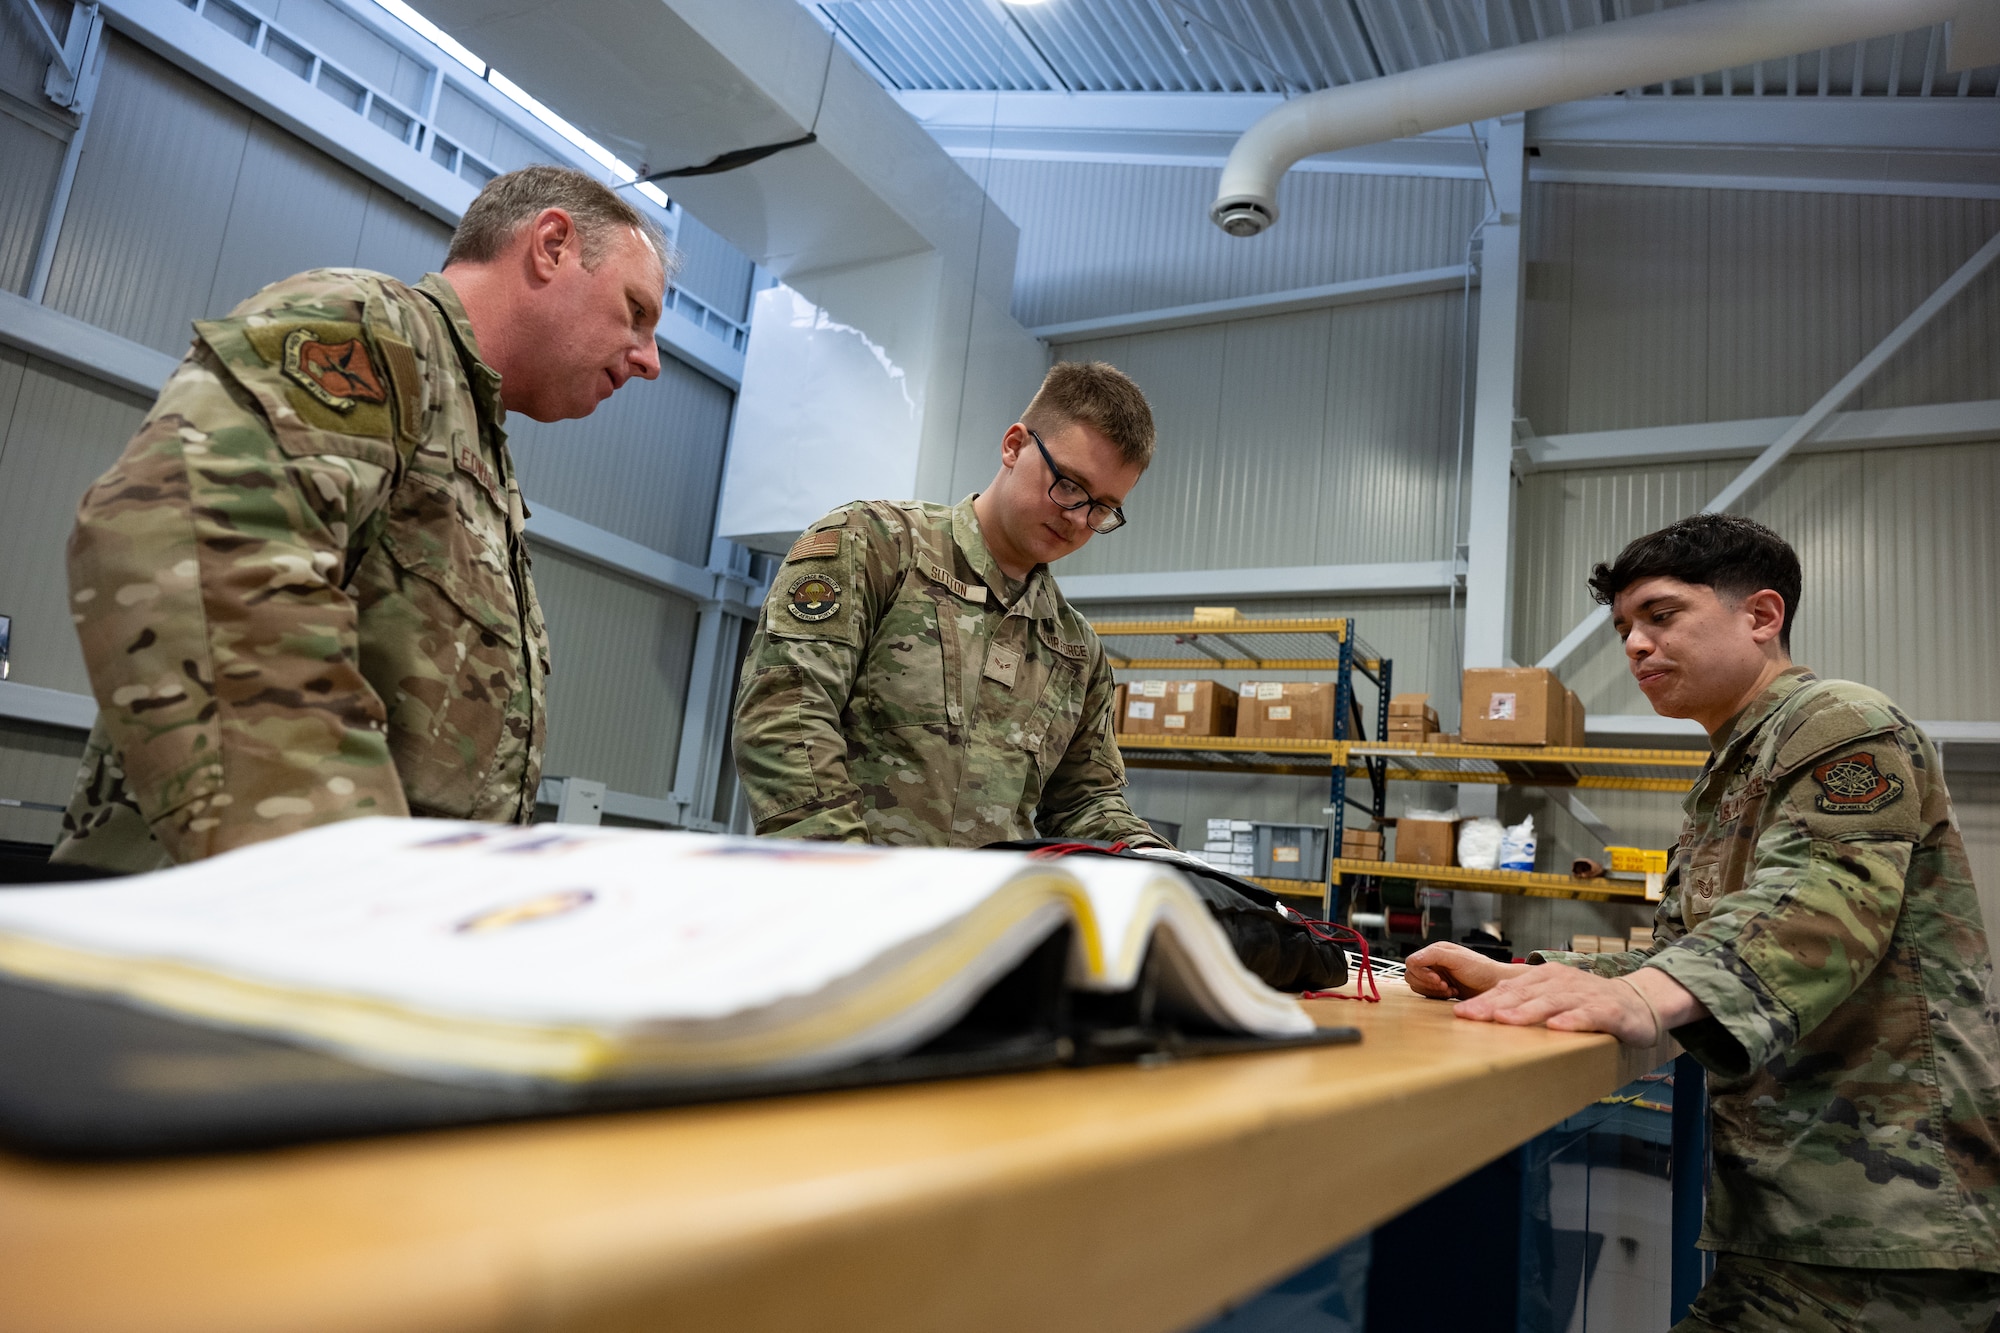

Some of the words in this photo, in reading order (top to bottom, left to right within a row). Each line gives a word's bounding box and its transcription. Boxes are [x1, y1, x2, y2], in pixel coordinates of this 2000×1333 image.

[818, 574, 839, 590] MOBILITY
[931, 566, 967, 597] SUTTON
[1046, 635, 1061, 651] AIR
[1060, 641, 1087, 657] FORCE
